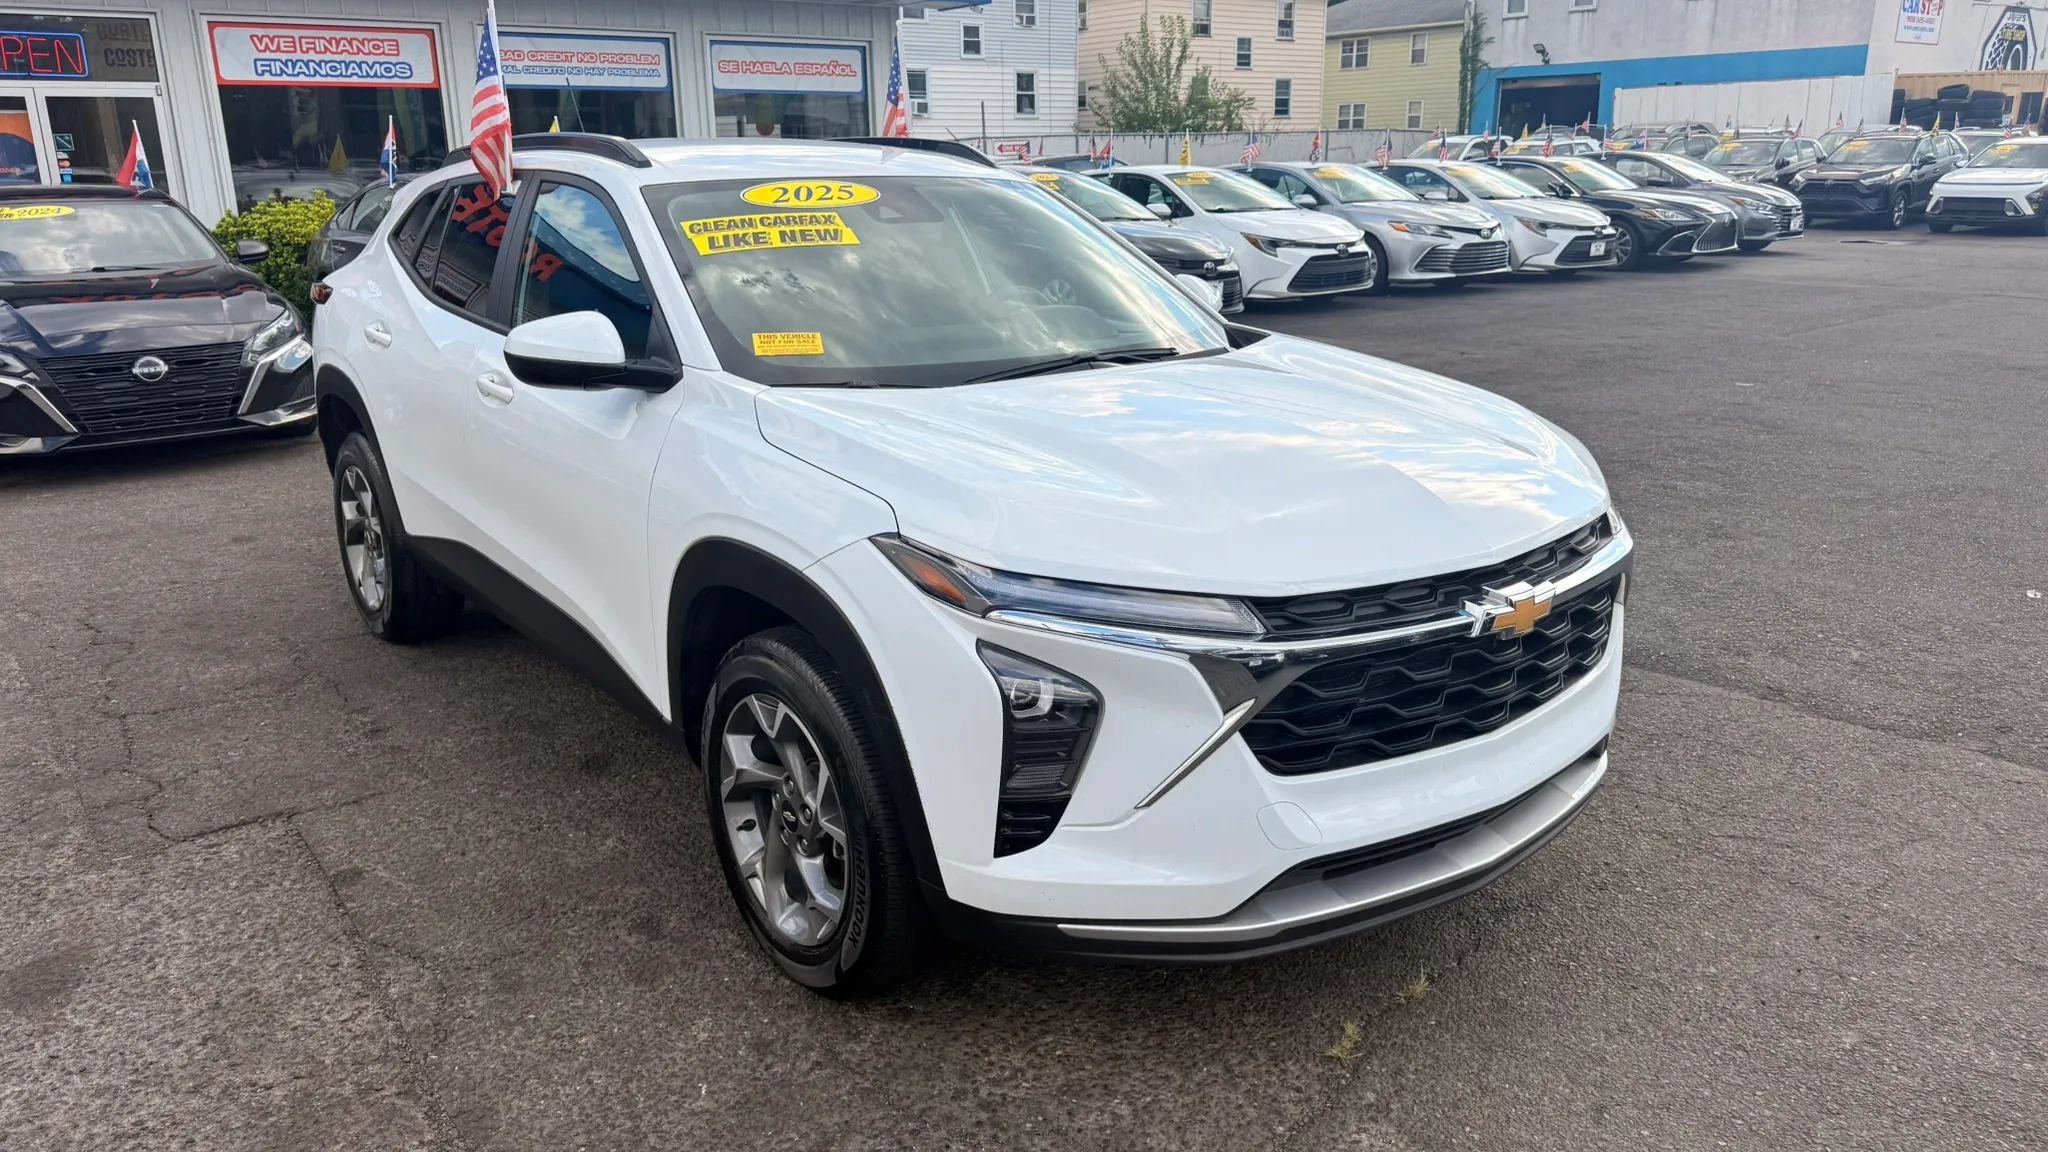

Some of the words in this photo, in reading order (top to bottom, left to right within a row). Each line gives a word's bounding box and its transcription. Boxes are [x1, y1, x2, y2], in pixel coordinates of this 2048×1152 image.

[0, 36, 83, 73] PEN
[251, 35, 296, 52] WE
[300, 37, 399, 55] FINANCE
[527, 51, 575, 63] CREDIT
[577, 52, 598, 64] NO
[600, 53, 660, 65] PROBLEM
[255, 60, 413, 78] FINANCIAMOS
[522, 66, 565, 75] CREDITO
[567, 67, 583, 75] NO
[584, 67, 606, 76] HAY
[607, 68, 660, 77] PROBLEMA
[718, 60, 739, 73] SE
[741, 61, 790, 75] HABLA
[794, 60, 856, 76] ESPAÑOL
[771, 185, 854, 204] 2025
[688, 217, 758, 235] CLEAN
[759, 214, 837, 228] CARFAX
[708, 231, 773, 251] LIKE
[779, 228, 842, 244] NEW
